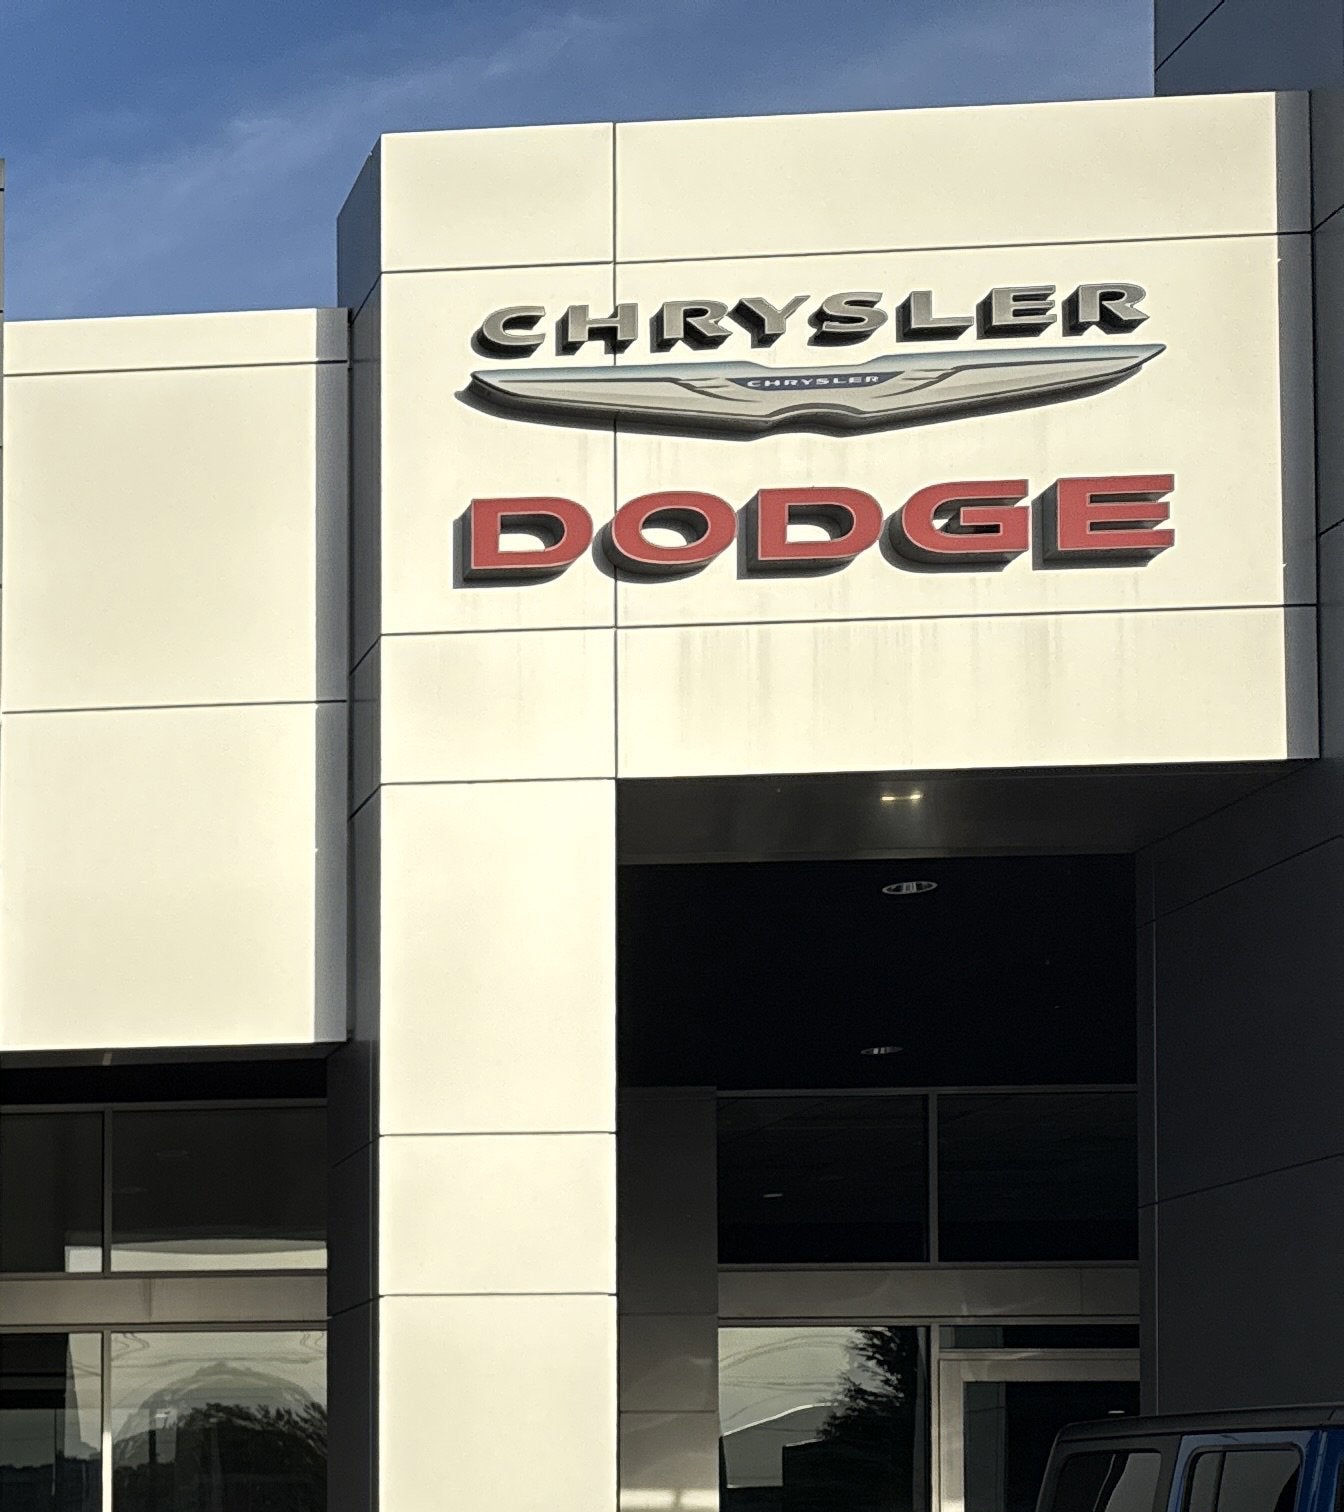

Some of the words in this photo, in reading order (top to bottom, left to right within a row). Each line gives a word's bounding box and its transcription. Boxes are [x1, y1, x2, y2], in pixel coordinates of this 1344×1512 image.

[472, 282, 1150, 357] CHRYSLER
[746, 375, 880, 388] CHRYSLER
[453, 474, 1175, 588] DODGE
